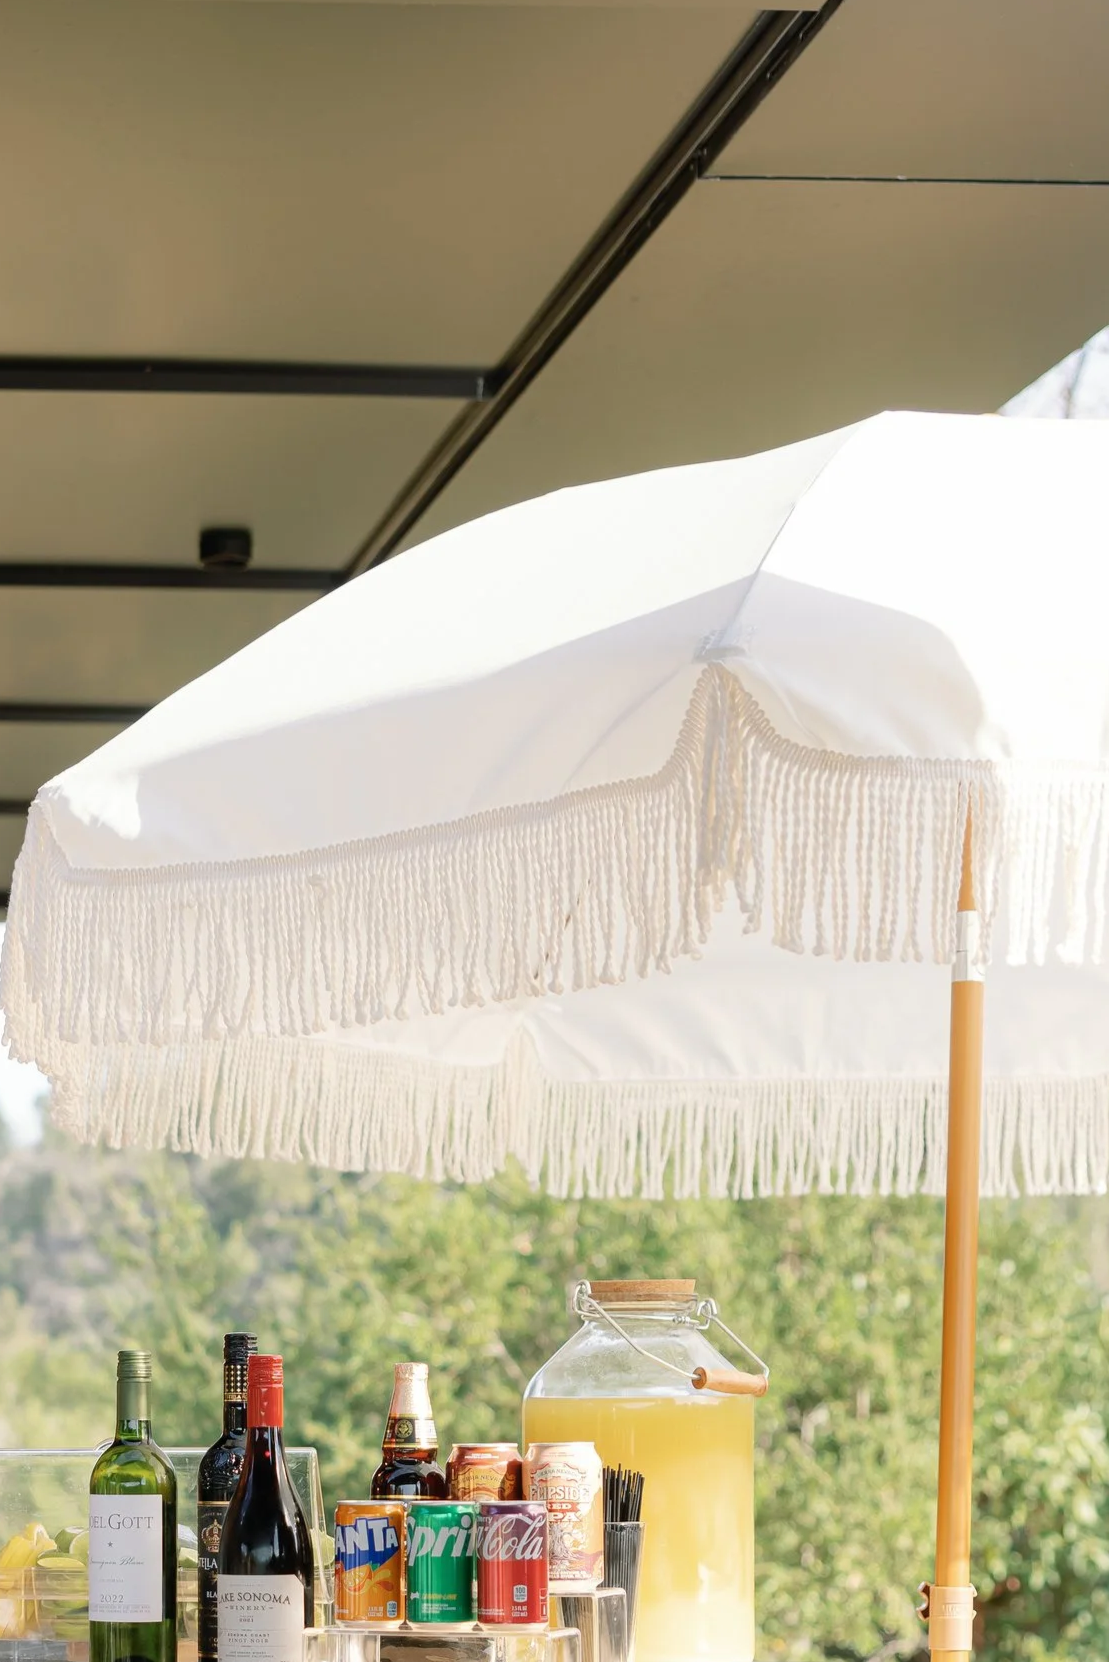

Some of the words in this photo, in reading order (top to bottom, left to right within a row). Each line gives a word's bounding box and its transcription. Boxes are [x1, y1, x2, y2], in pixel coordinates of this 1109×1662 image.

[529, 1484, 591, 1500] FLIPSIDE
[89, 1515, 107, 1529] OEL
[548, 1511, 580, 1521] PA
[335, 1519, 398, 1555] ANTA
[206, 1590, 218, 1599] BLA
[515, 1586, 526, 1594] 100
[100, 1594, 124, 1603] 2022
[236, 1591, 291, 1605] SONOMA
